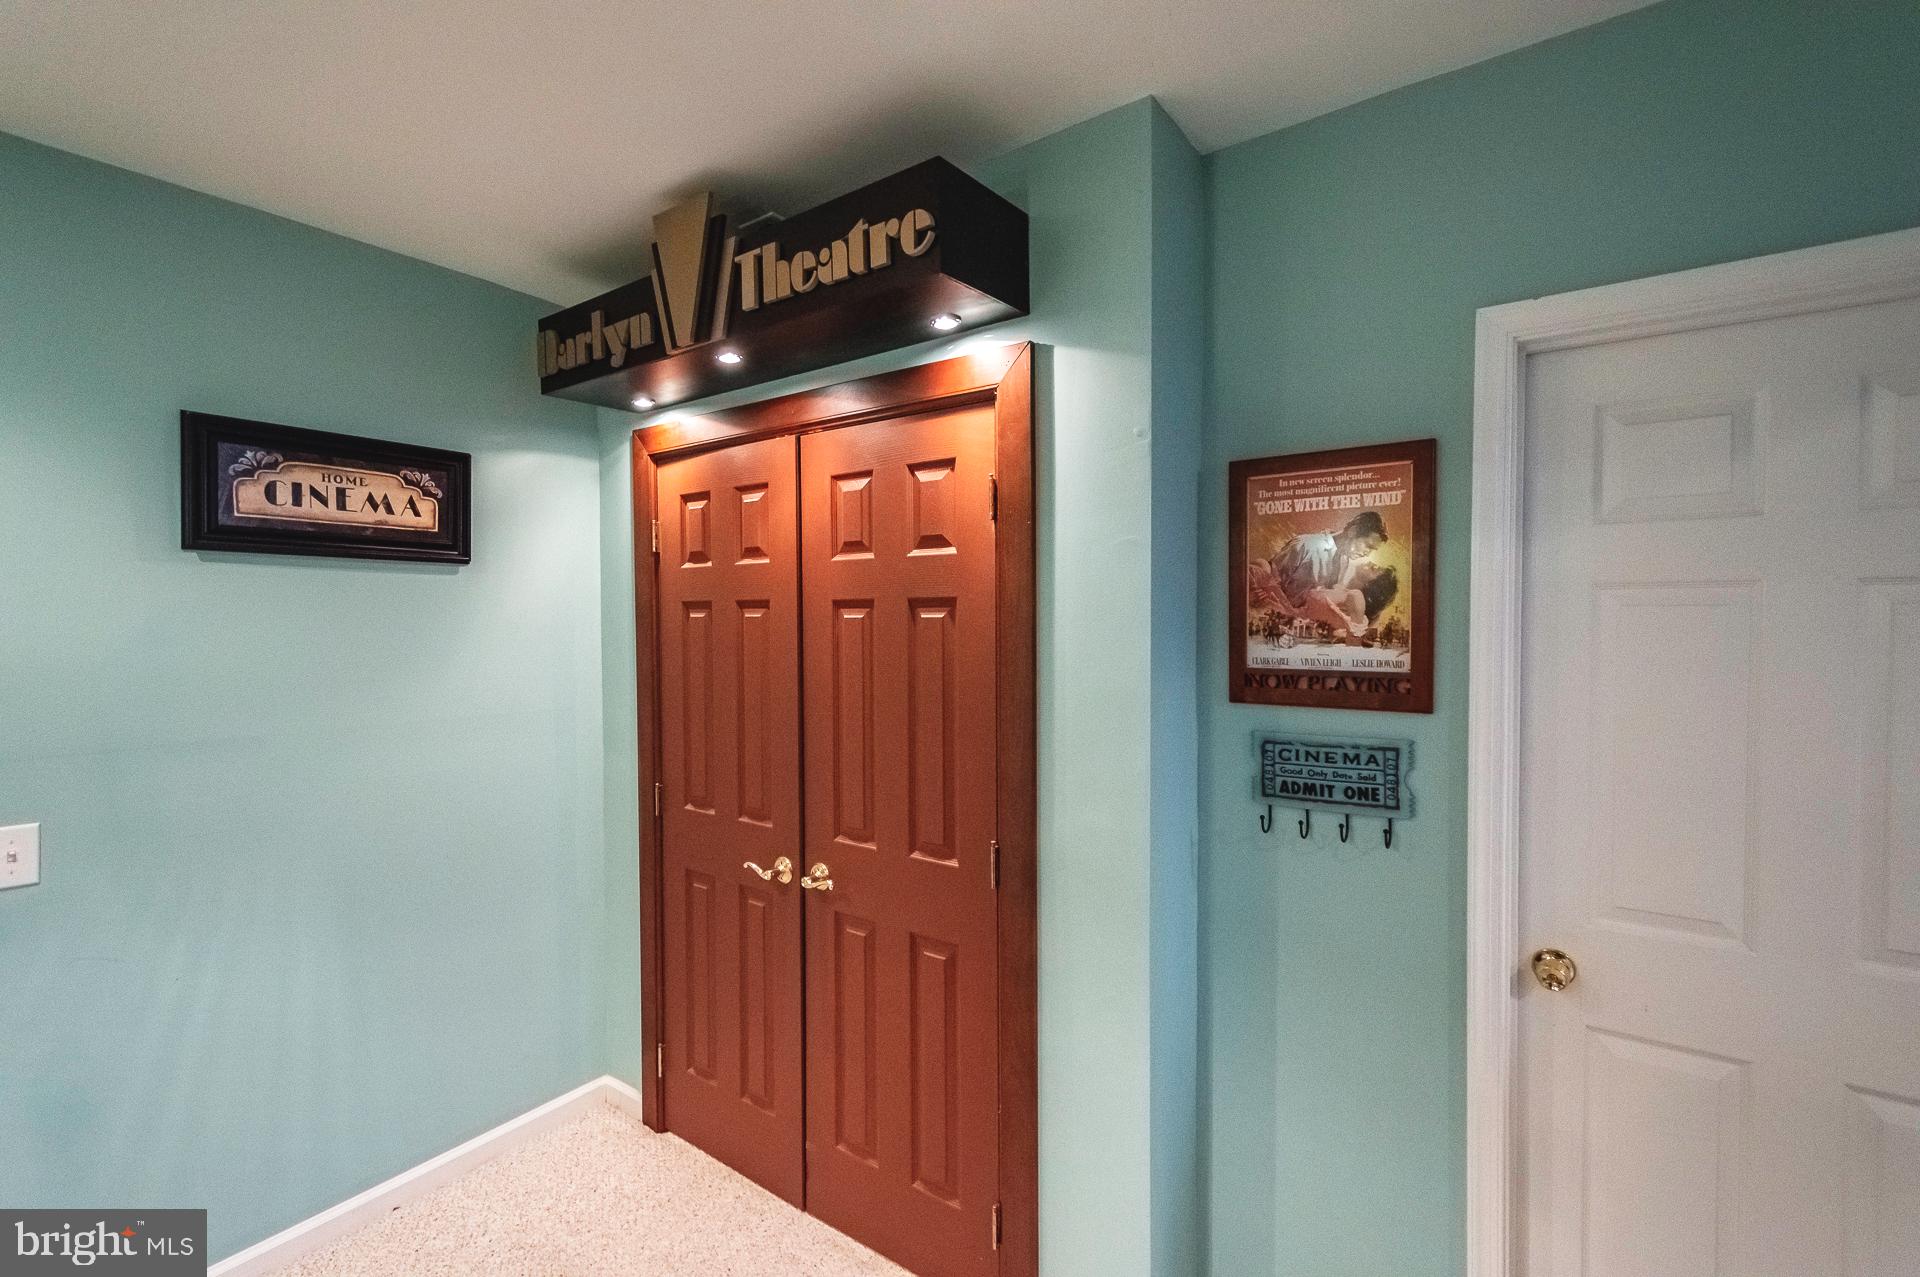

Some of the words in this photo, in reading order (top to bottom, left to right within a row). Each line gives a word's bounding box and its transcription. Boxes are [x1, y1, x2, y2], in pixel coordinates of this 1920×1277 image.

[734, 209, 936, 312] Theatre
[322, 473, 368, 487] HOME
[1259, 490, 1272, 498] The
[1274, 488, 1294, 496] most
[1295, 482, 1345, 495] magnificent
[1346, 480, 1376, 491] picture
[1378, 477, 1401, 488] ever!
[1279, 479, 1288, 487] In
[1306, 475, 1333, 484] screen
[264, 480, 422, 518] CINEMA
[1294, 497, 1329, 512] WITH
[1330, 494, 1361, 509] THE
[1352, 659, 1374, 668] LESLIE
[1376, 660, 1405, 669] HOWARD
[1245, 674, 1298, 689] NOW
[1306, 675, 1411, 695] PLAYING
[1278, 748, 1380, 767] CINEMA
[1280, 766, 1303, 775] Good
[1307, 768, 1328, 779] Only
[1279, 780, 1335, 799] ADMIT
[1343, 785, 1381, 802] ONE
